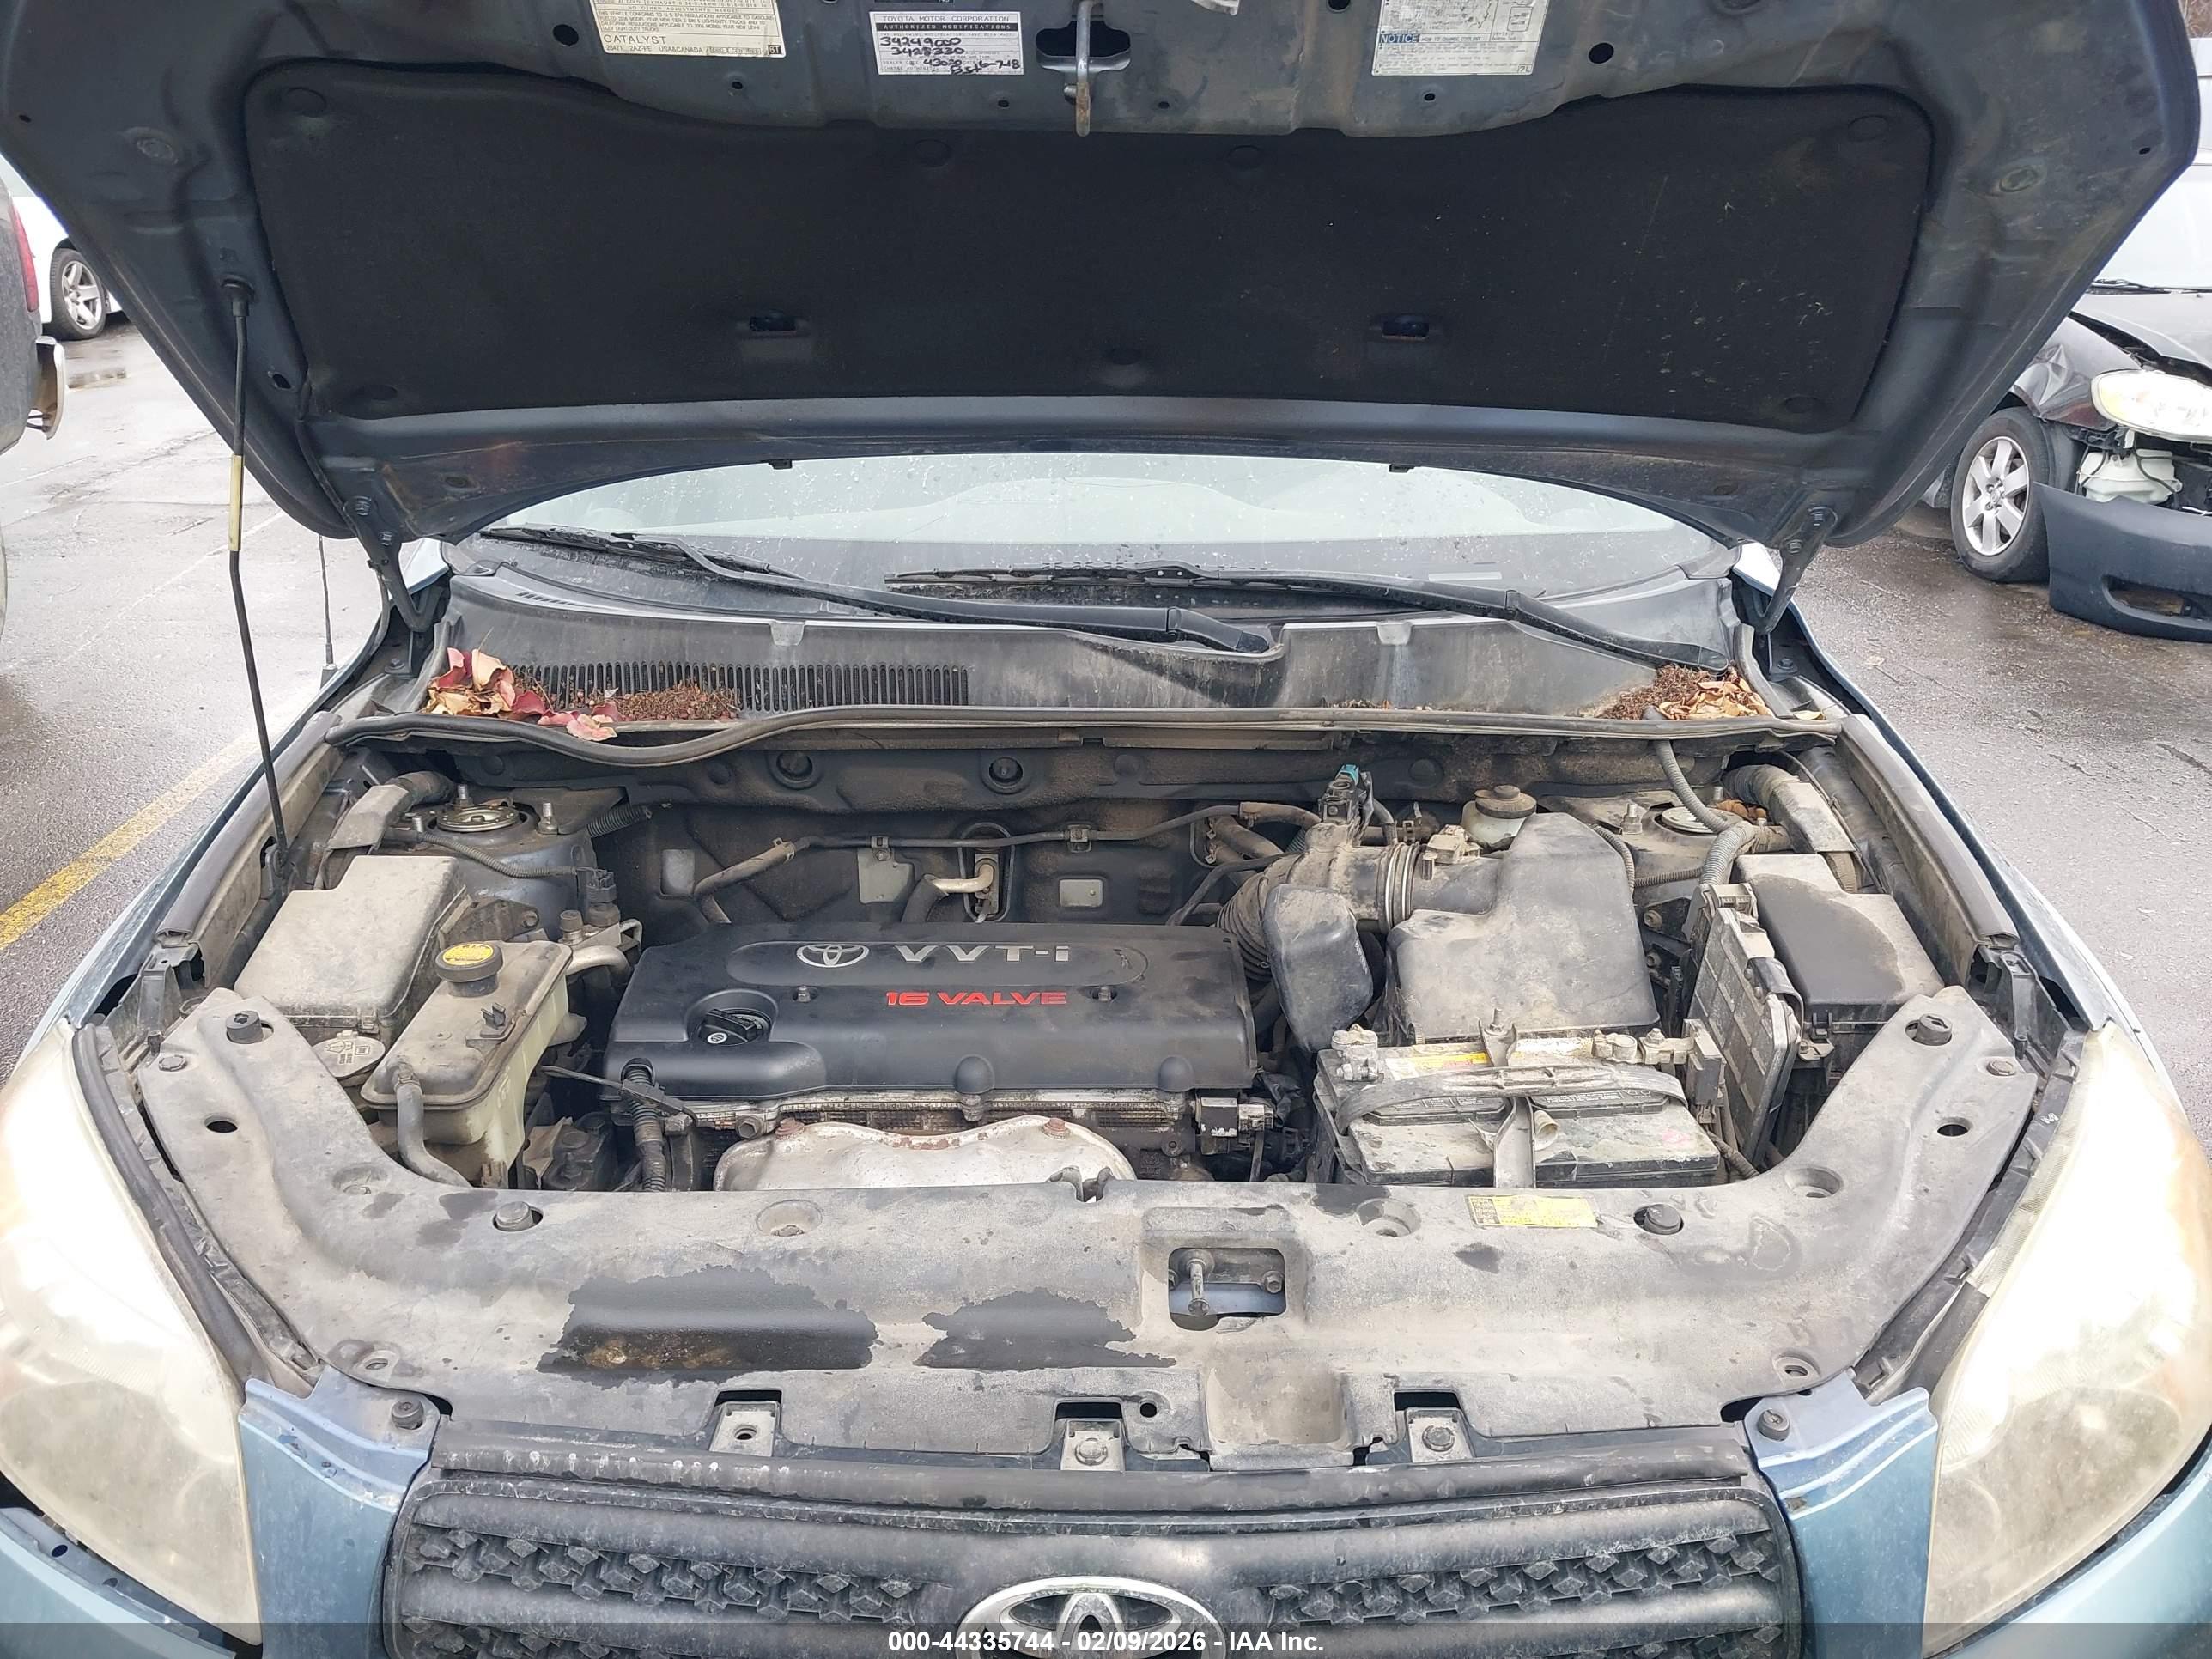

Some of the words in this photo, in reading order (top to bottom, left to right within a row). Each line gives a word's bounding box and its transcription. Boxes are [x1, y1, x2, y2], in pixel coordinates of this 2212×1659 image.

[604, 34, 666, 45] CATALYST
[1380, 34, 1418, 43] NOTICE
[894, 945, 1069, 962] VVT-i
[886, 992, 929, 1006] 16
[937, 992, 1067, 1006] VALVE
